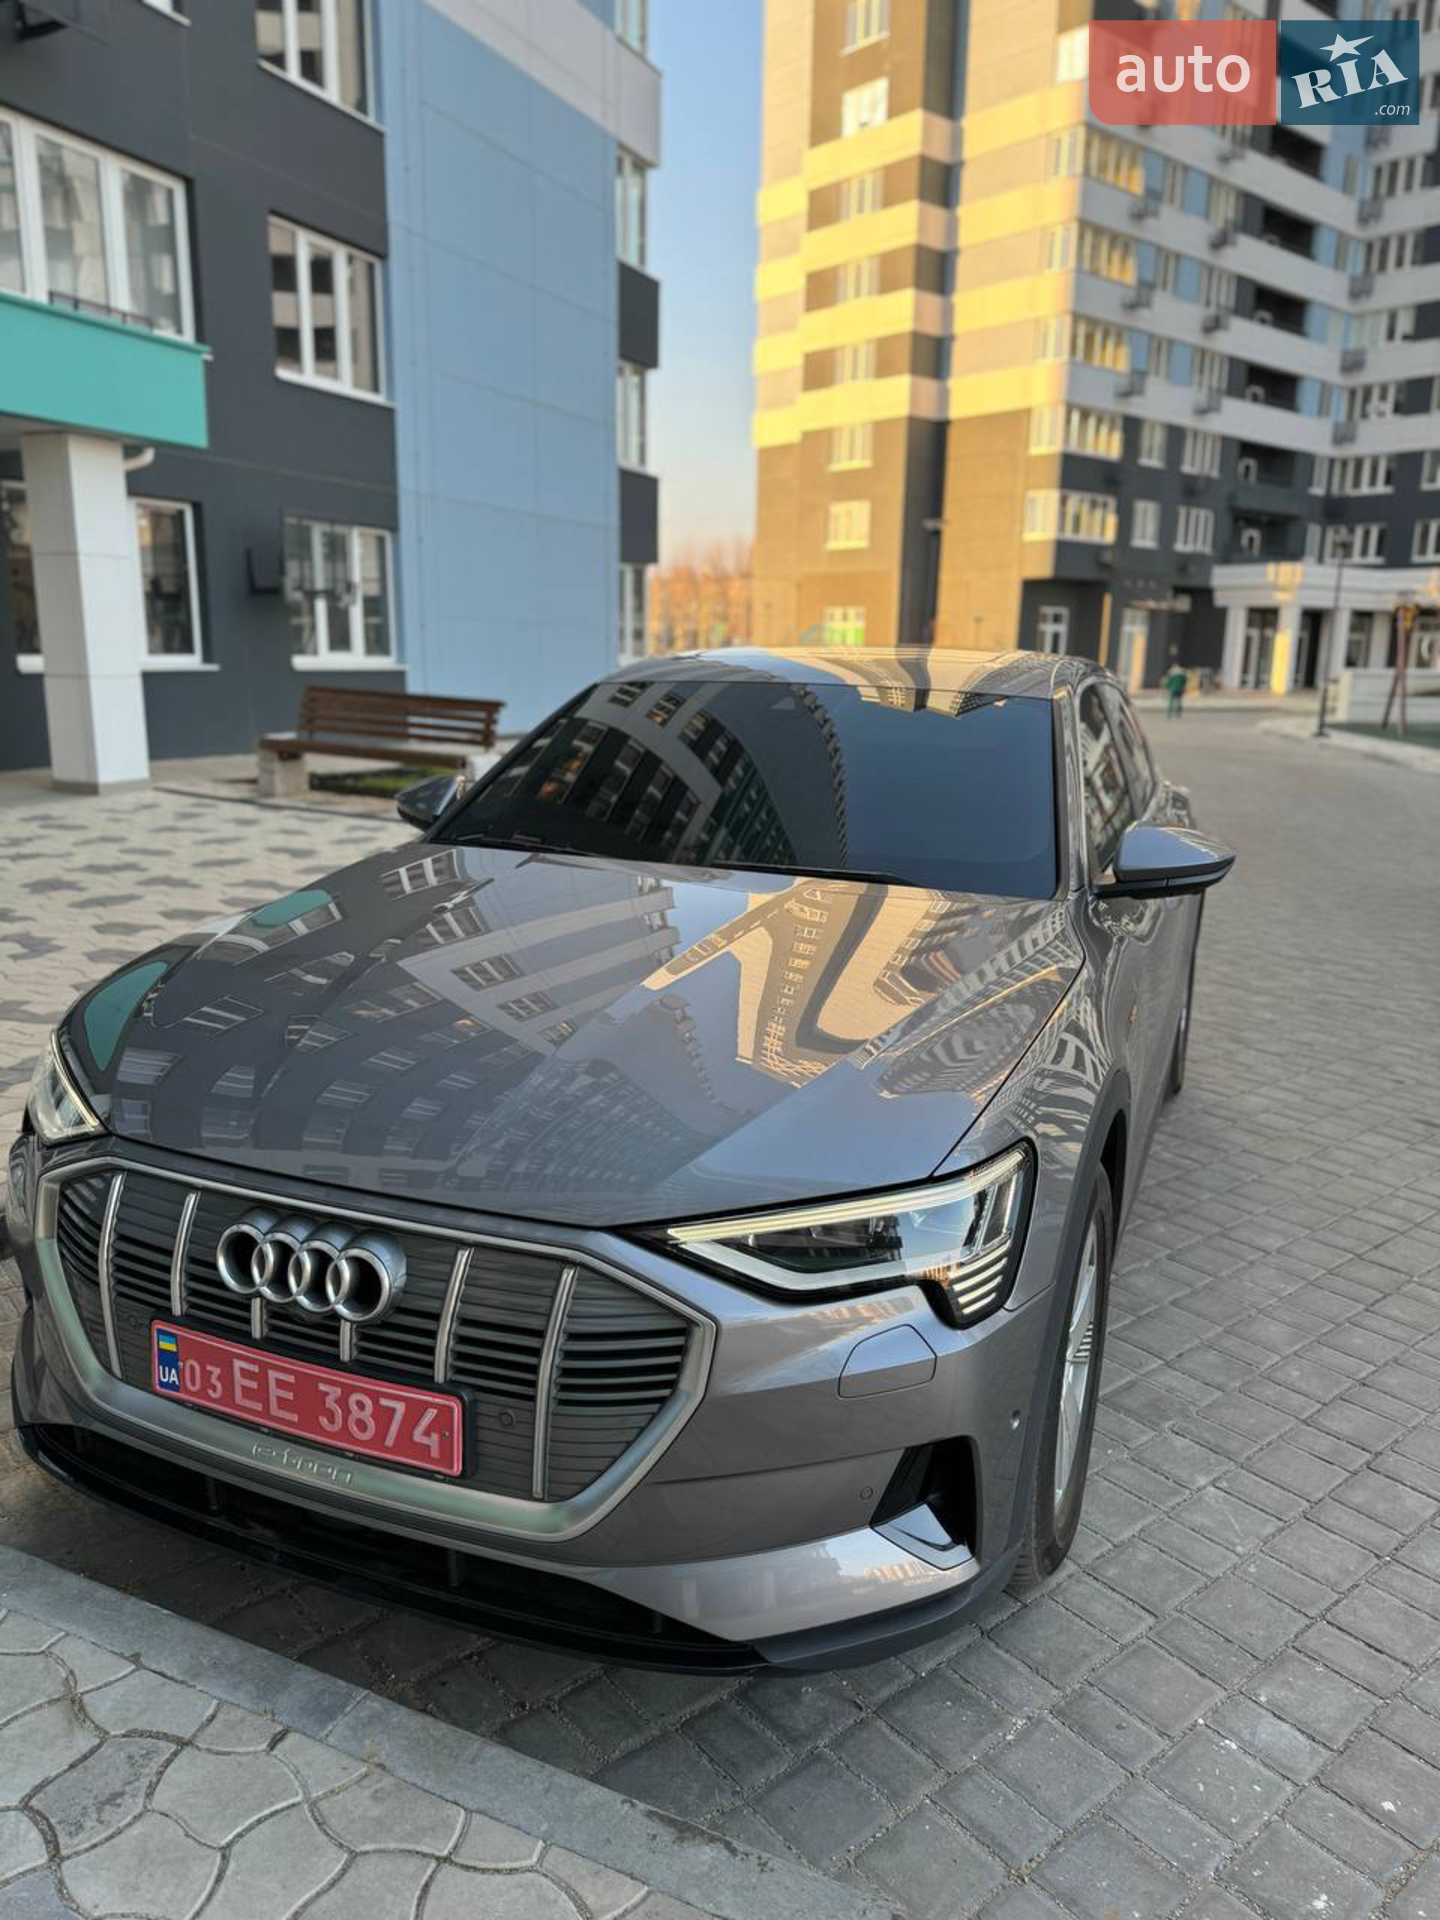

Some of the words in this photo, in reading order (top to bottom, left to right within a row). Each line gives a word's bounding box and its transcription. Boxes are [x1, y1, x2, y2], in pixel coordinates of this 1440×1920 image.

[159, 1364, 180, 1386] UA
[185, 1359, 223, 1399] 03
[232, 1358, 299, 1423] EE
[317, 1382, 441, 1459] 3874
